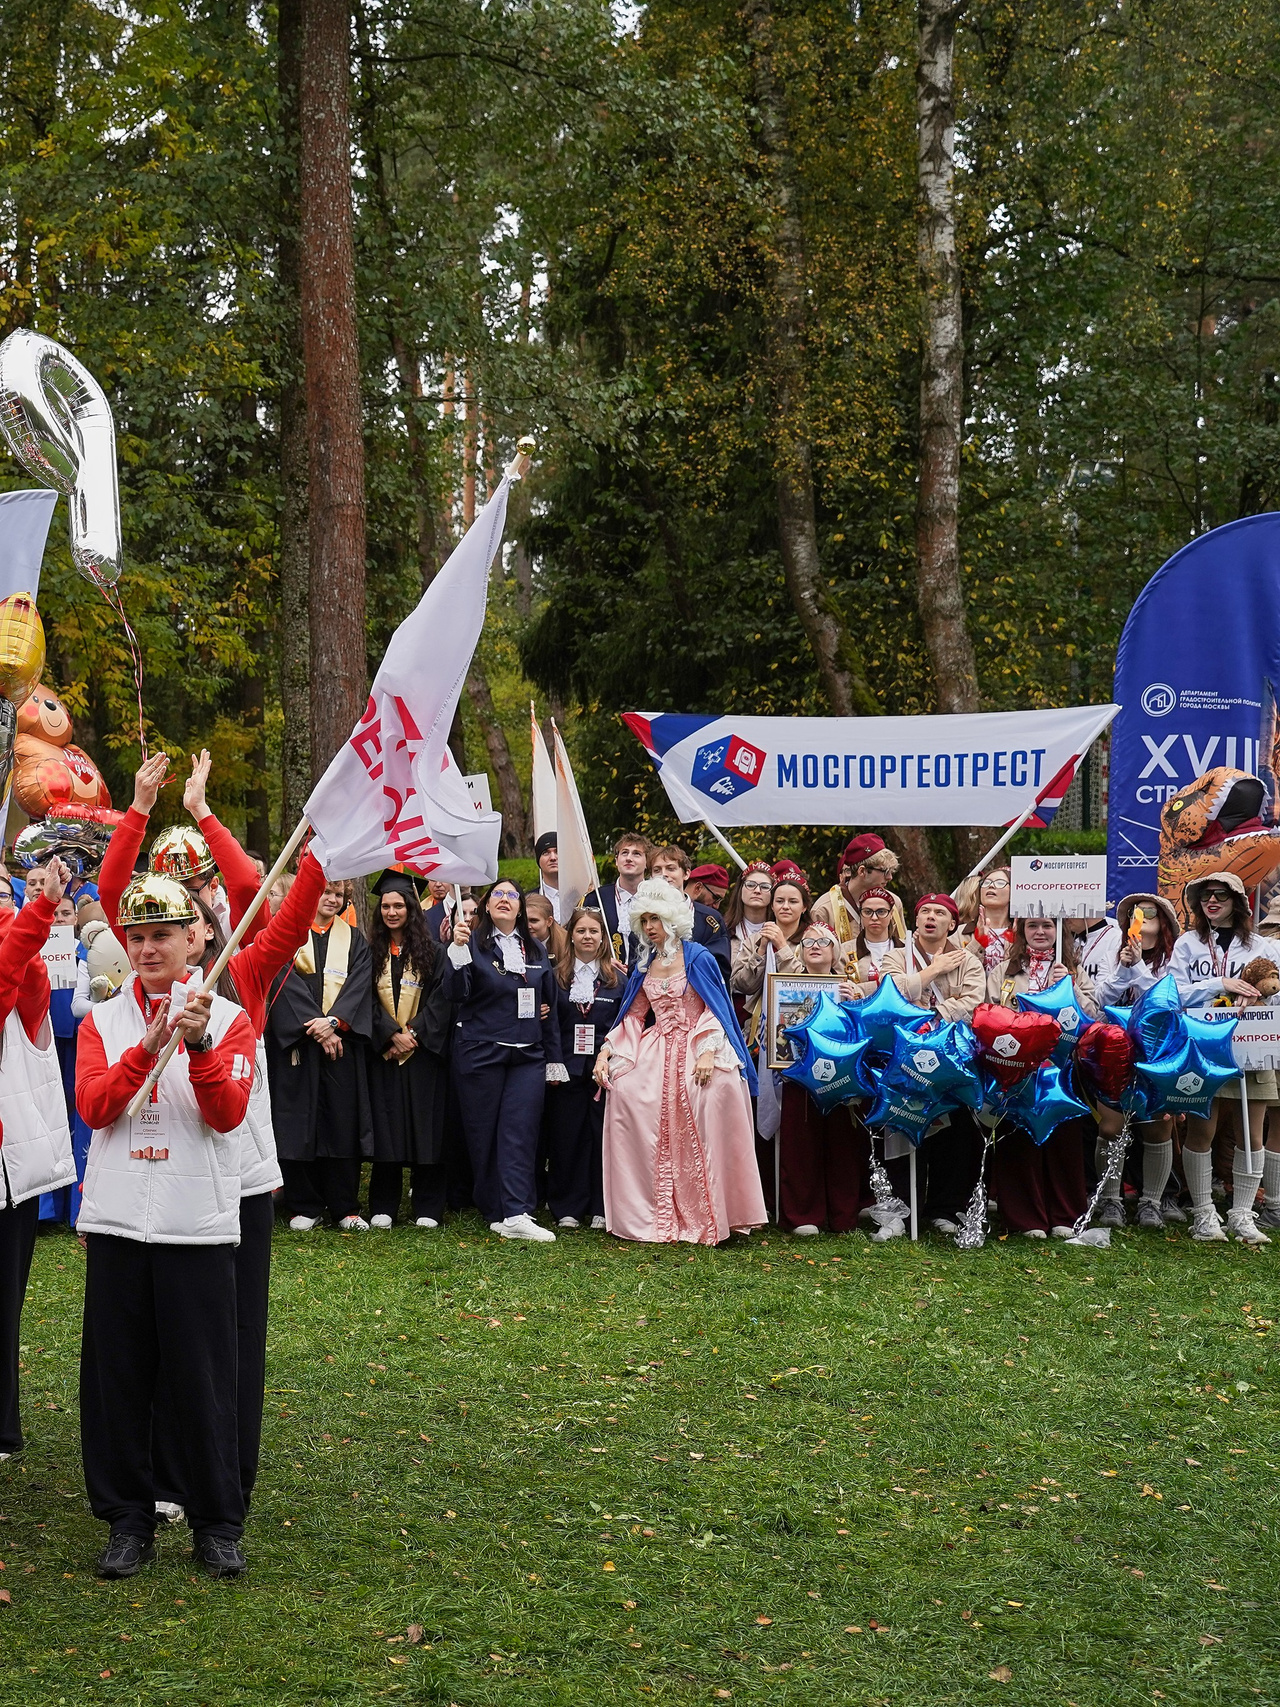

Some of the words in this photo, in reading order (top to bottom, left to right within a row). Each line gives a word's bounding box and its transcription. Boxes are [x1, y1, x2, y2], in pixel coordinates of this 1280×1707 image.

[777, 748, 1046, 788] МОСГОРГЕОТРЕСТ
[1044, 861, 1088, 869] МОСГОРГЕОТРЕСТ
[1215, 1011, 1274, 1021] МОСИЖПРОЕКТ
